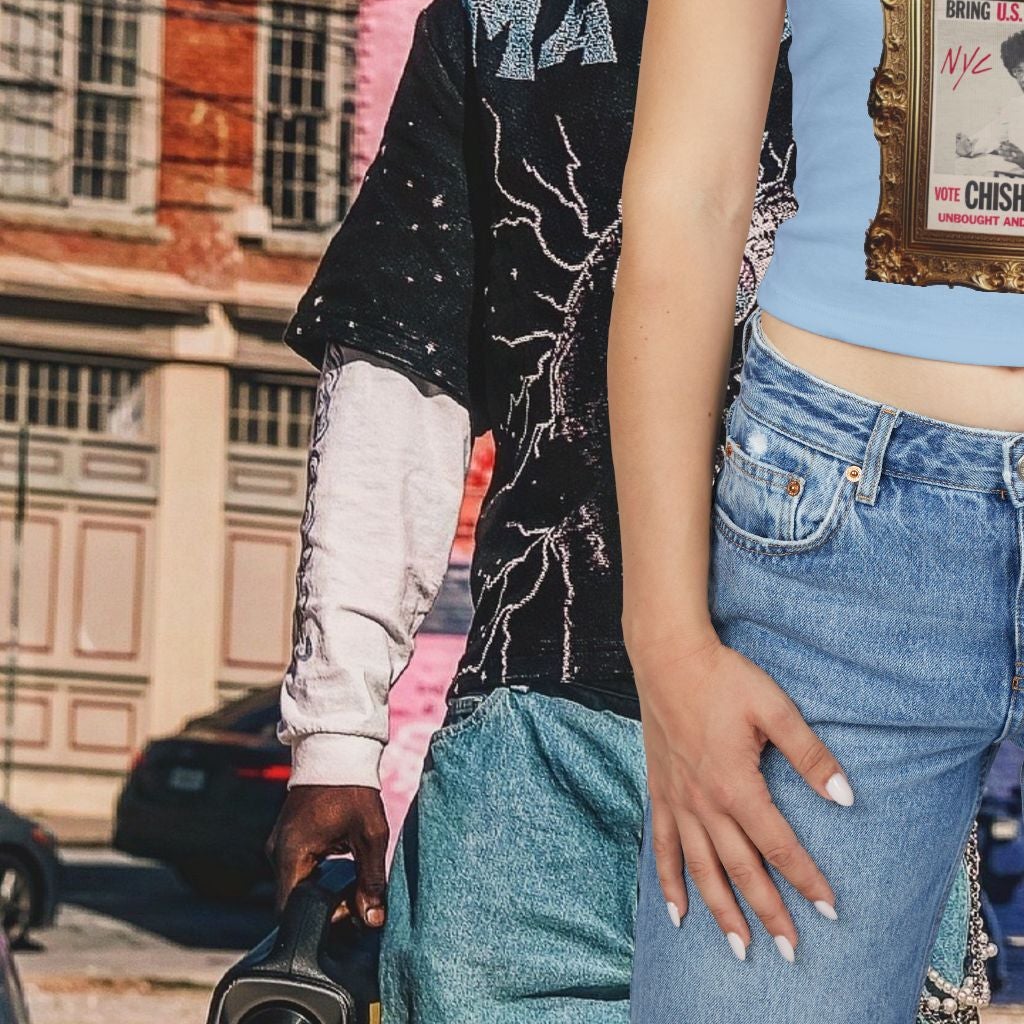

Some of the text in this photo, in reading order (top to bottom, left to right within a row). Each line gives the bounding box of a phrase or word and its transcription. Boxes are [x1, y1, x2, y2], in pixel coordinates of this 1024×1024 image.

[945, 0, 990, 20] BRING
[996, 2, 1023, 22] U.S.
[940, 45, 992, 91] NYC
[934, 186, 960, 202] VOTE
[938, 212, 1000, 226] UNBOUGHT
